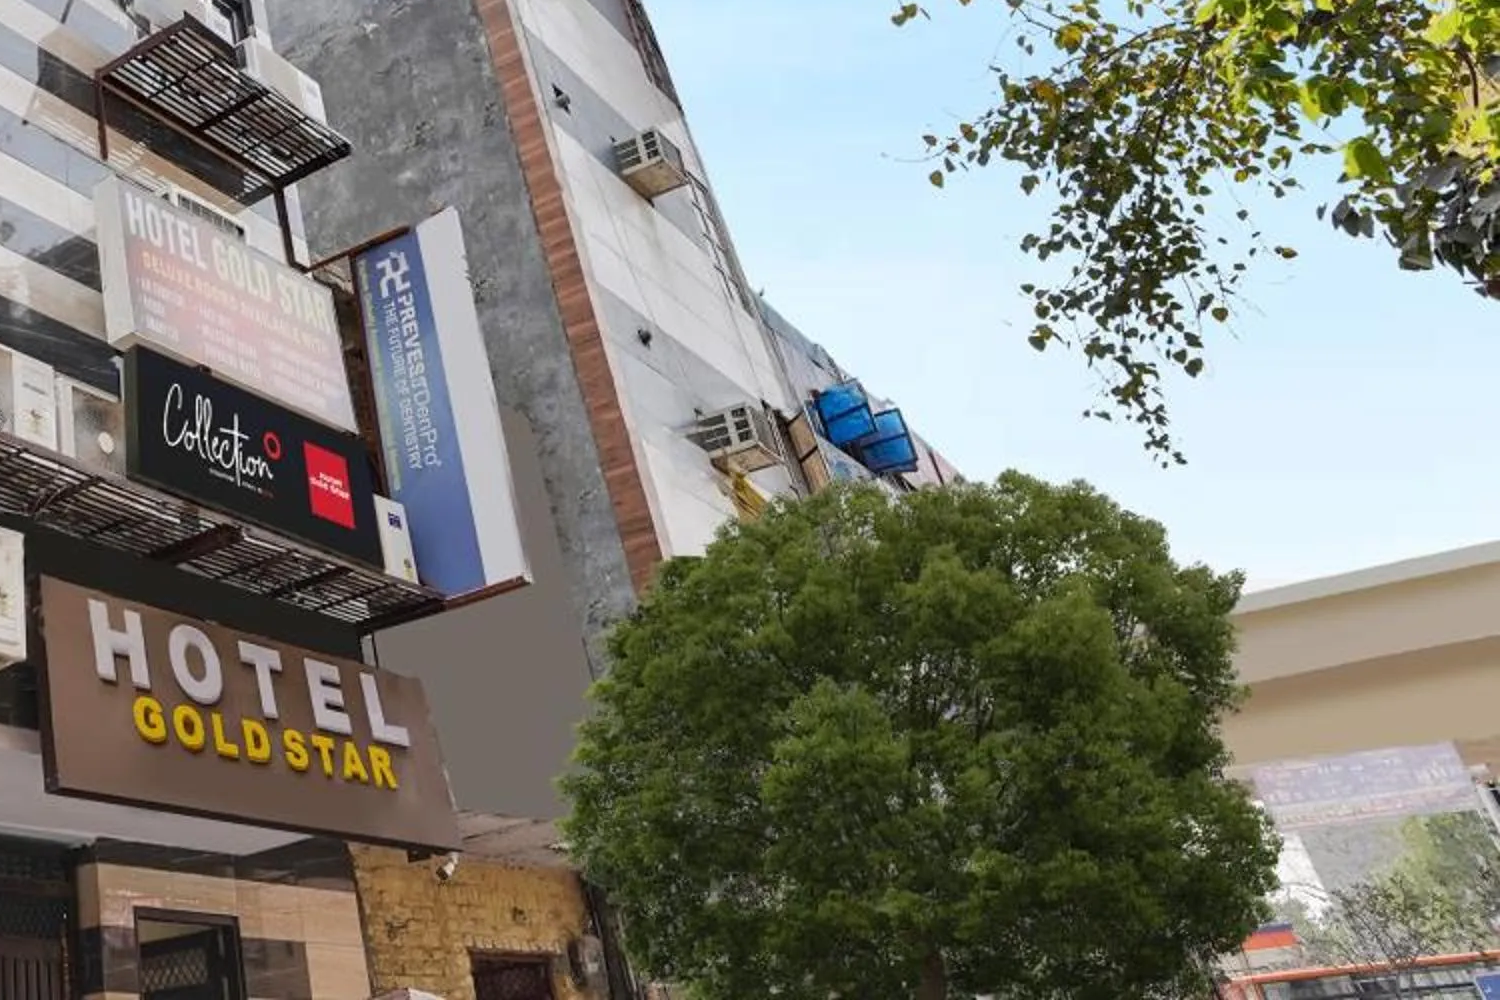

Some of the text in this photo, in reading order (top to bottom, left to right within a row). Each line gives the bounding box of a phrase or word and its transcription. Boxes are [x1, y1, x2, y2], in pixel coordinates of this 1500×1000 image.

[125, 192, 207, 271] HOTEL
[212, 237, 271, 301] GOLD
[276, 271, 332, 336] STAR
[383, 302, 397, 326] THE
[388, 327, 406, 378] FUTURE
[163, 383, 274, 487] Collection
[400, 399, 422, 470] DENTISTRY
[87, 598, 411, 747] HOTEL
[133, 696, 398, 789] GOLD STAR
